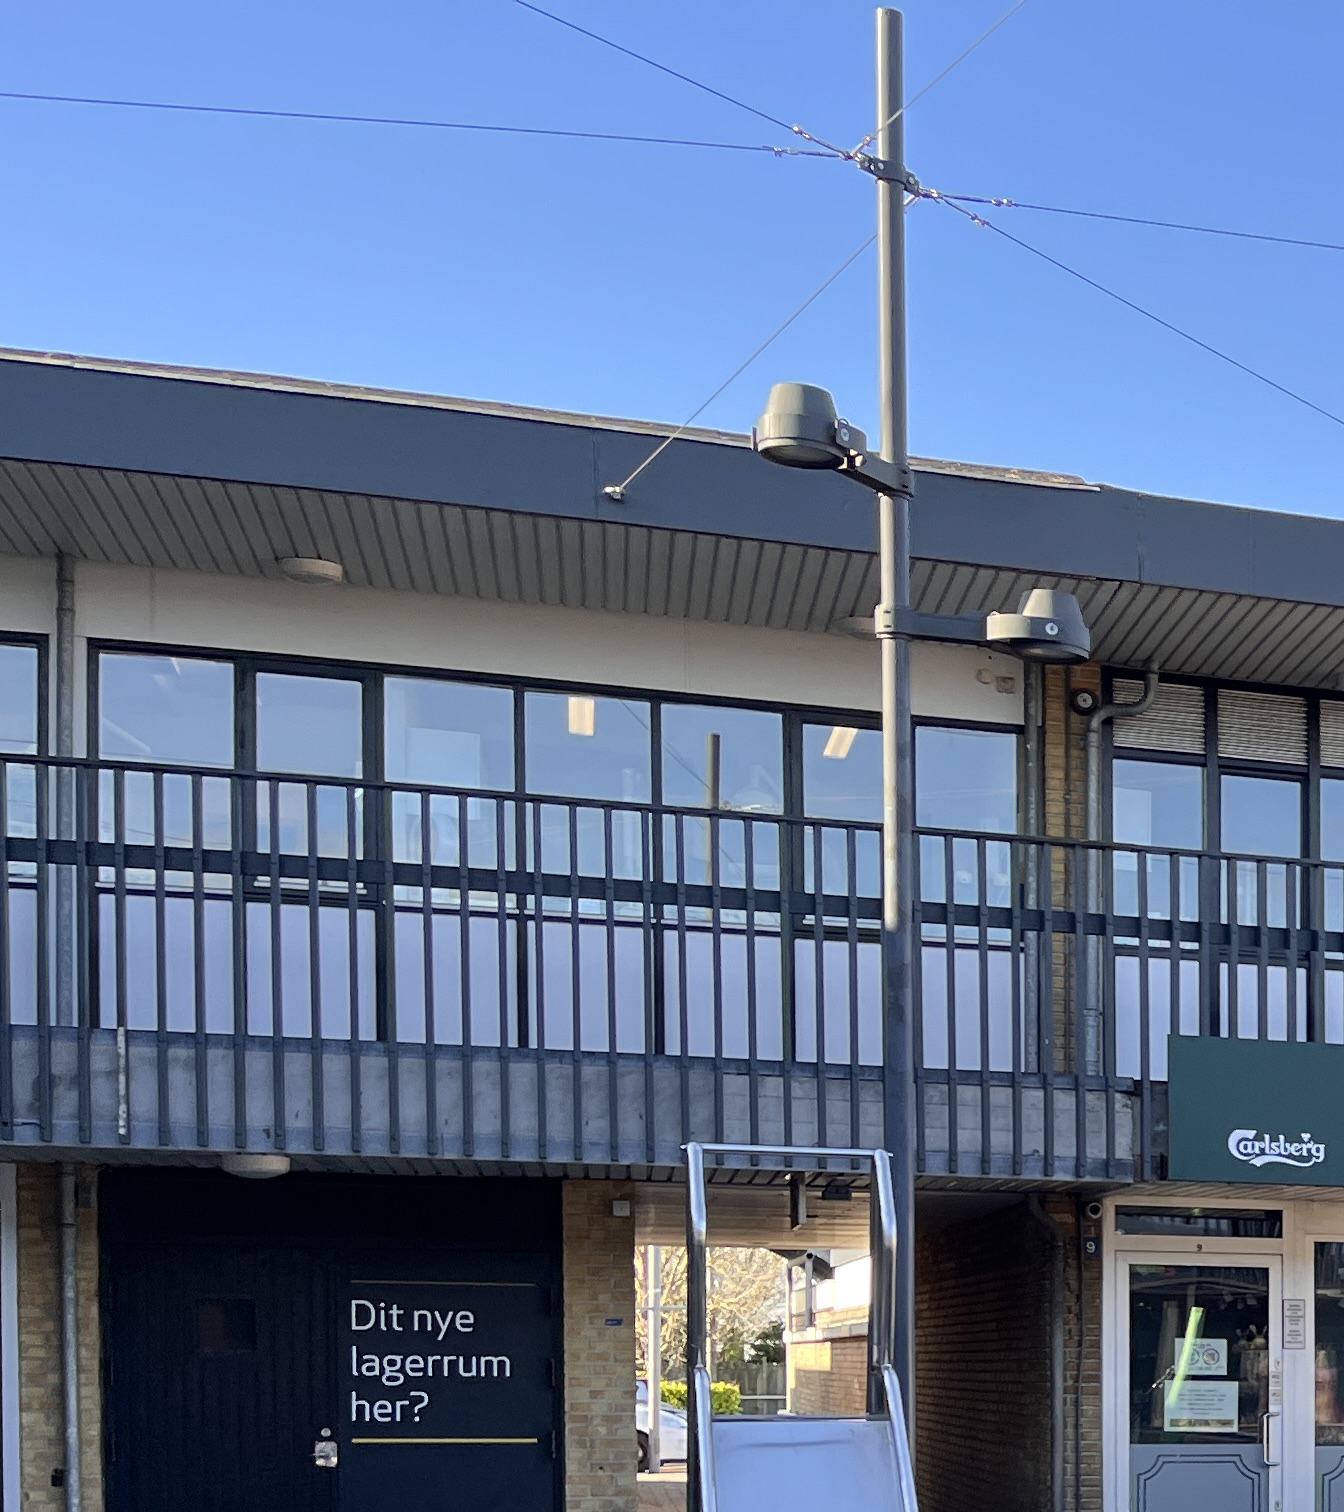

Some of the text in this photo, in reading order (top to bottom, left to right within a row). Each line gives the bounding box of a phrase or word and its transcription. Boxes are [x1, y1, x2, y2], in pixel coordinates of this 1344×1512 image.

[1227, 1129, 1326, 1167] Carlsberg
[1086, 1241, 1096, 1253] 9
[351, 1299, 475, 1341] Dit nye
[351, 1345, 511, 1387] lagerrum
[351, 1390, 429, 1422] her?
